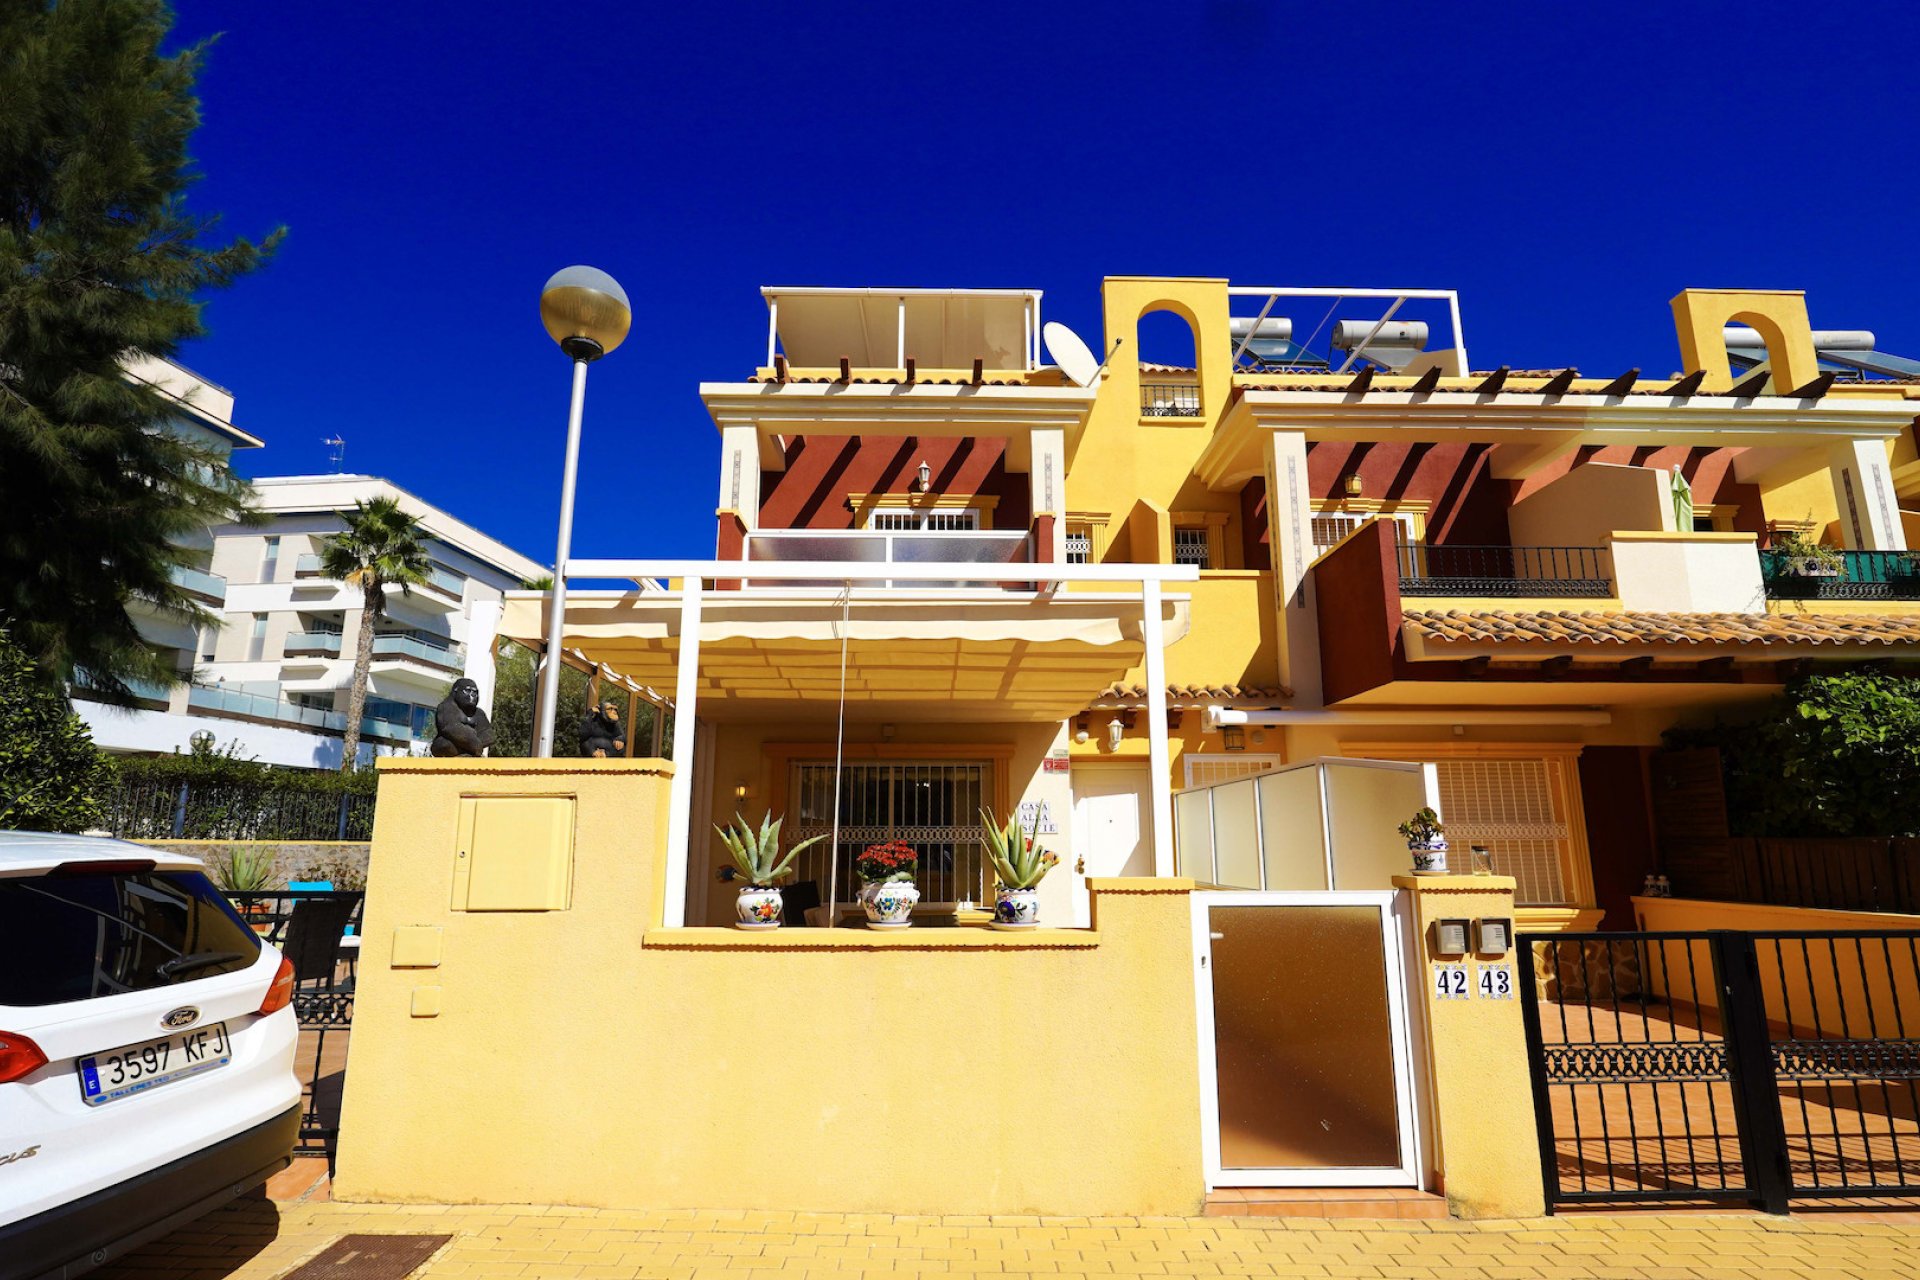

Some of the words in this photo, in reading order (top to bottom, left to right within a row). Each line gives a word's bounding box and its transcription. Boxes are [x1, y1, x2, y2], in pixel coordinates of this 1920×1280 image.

[1021, 803, 1048, 811] CASA
[1021, 813, 1048, 821] ALA
[1437, 970, 1466, 994] 42
[1481, 970, 1510, 994] 43
[170, 1010, 195, 1026] Ford
[107, 1041, 170, 1085] 3597
[182, 1028, 224, 1063] KFJ
[88, 1080, 96, 1090] E
